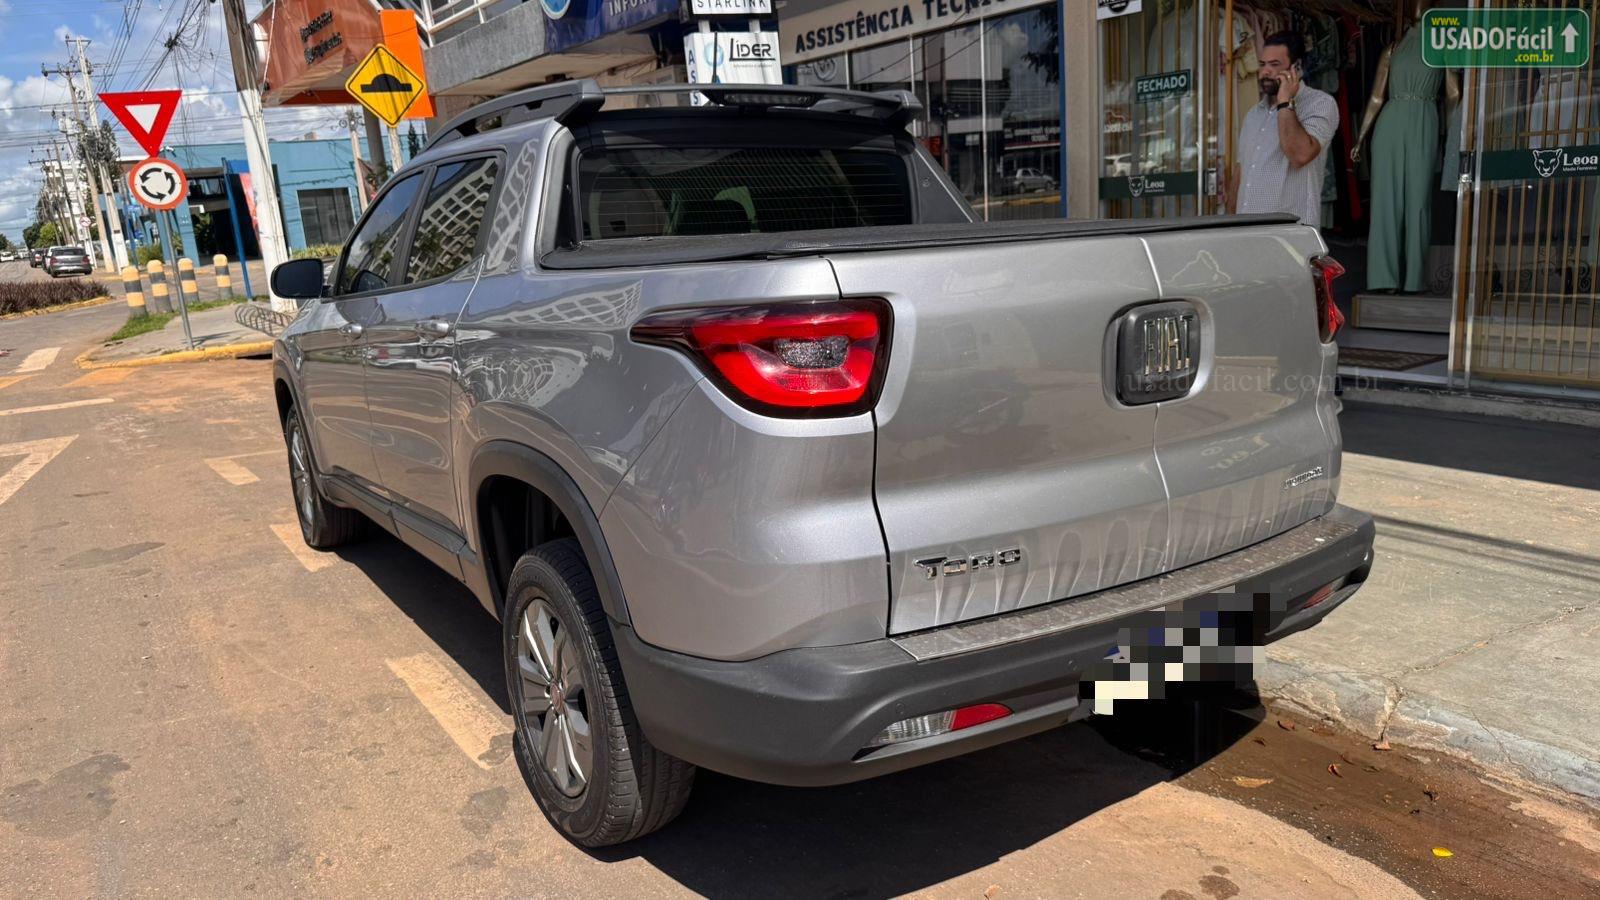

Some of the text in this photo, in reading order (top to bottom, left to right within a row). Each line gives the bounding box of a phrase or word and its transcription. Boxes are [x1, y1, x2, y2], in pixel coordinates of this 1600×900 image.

[697, 0, 766, 8] STARLINK
[795, 12, 914, 53] ASSISTÊNCIA
[1137, 75, 1187, 93] FECHADO
[1563, 153, 1598, 166] Leoa
[1145, 179, 1165, 189] Leoa
[1144, 314, 1193, 375] FIAT
[913, 548, 1021, 580] TORO
